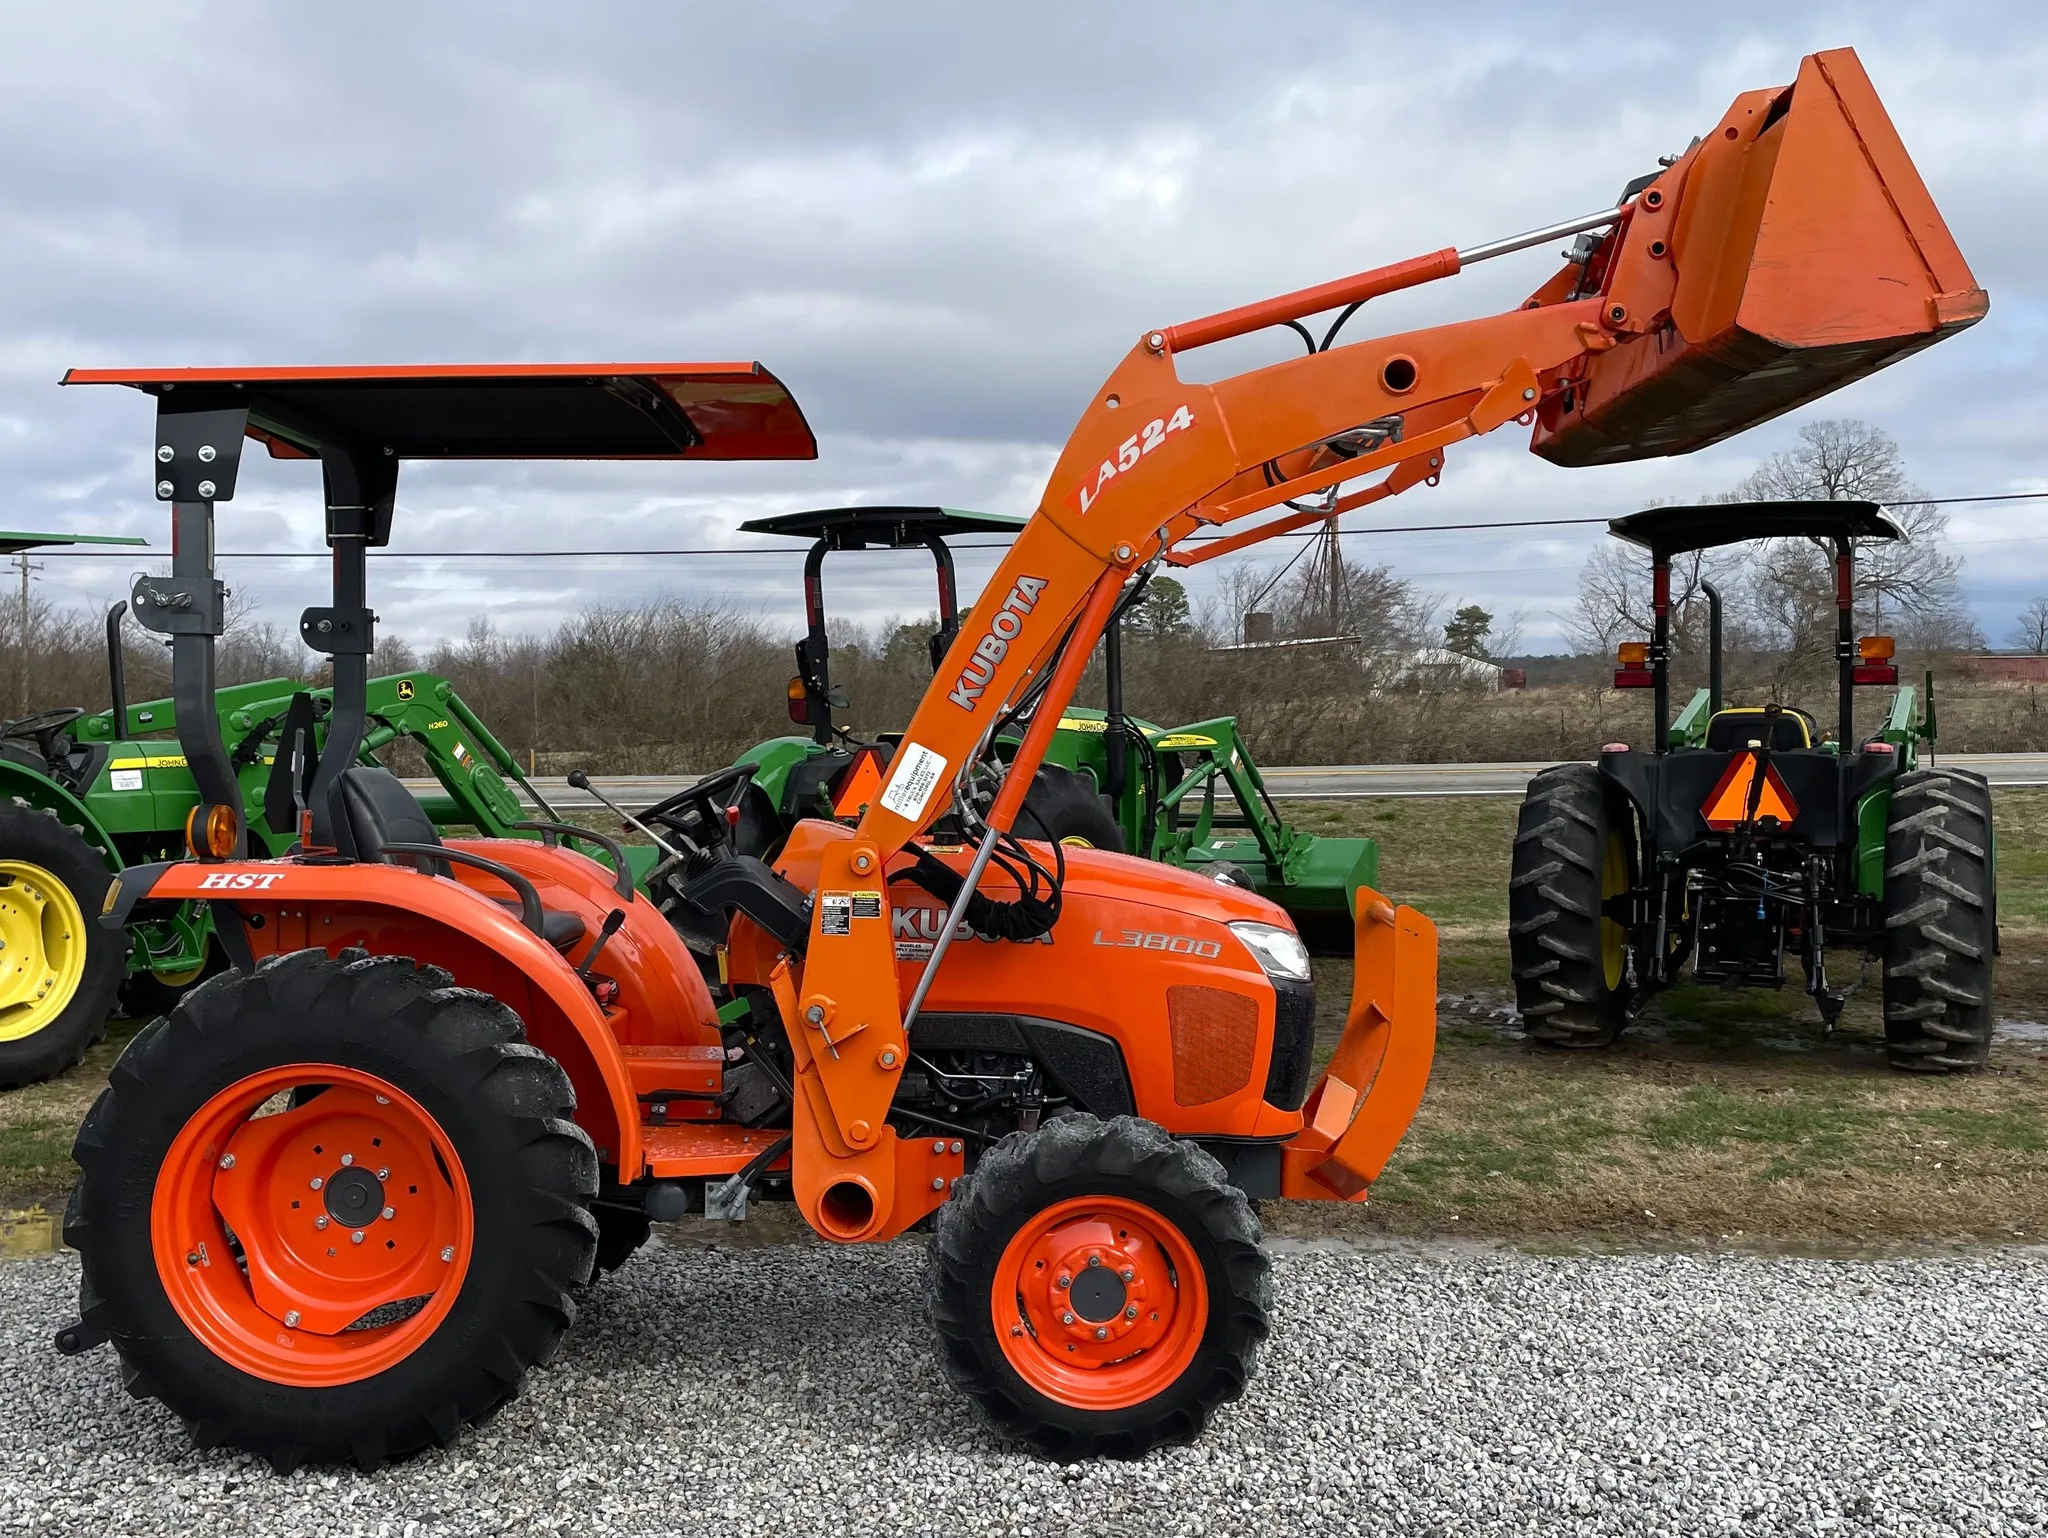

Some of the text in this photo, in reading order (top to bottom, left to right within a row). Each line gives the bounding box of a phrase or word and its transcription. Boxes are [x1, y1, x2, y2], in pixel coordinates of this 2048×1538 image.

[1080, 404, 1195, 516] LA524
[947, 574, 1049, 713] KUBOTA
[428, 720, 449, 730] H260
[1077, 722, 1096, 732] JOHN
[157, 759, 181, 767] JOHN
[915, 771, 926, 786] SALES
[197, 873, 285, 889] HST
[1093, 929, 1222, 959] L3800
